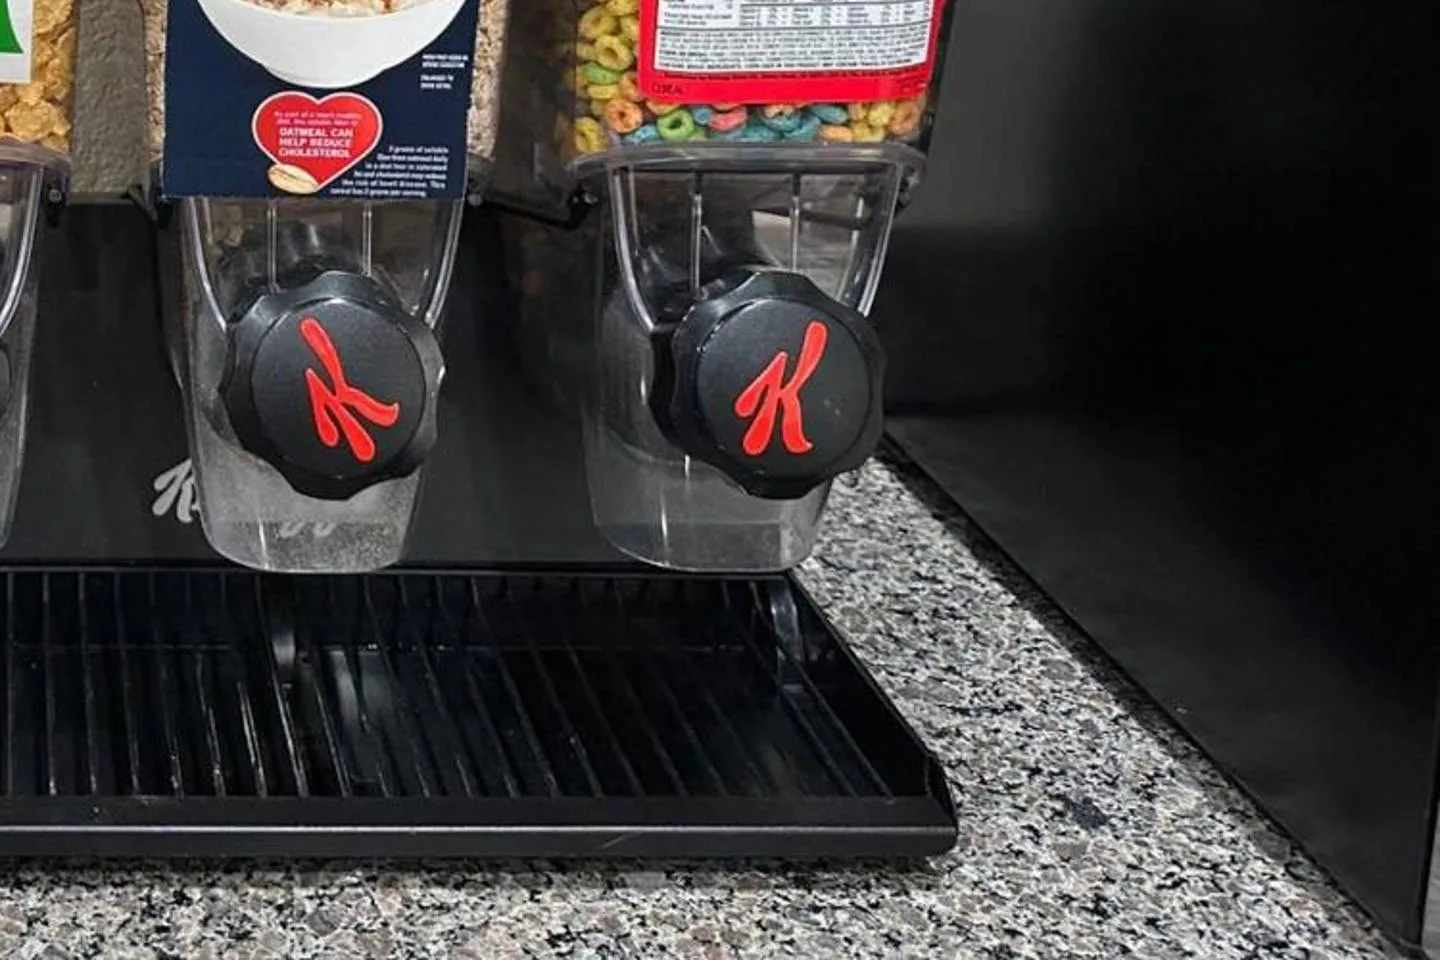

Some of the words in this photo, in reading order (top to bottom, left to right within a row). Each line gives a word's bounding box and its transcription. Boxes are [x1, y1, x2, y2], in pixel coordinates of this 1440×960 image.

[280, 128, 329, 137] OATMEAL
[330, 128, 354, 137] CAN
[280, 138, 307, 147] HELP
[308, 138, 352, 147] REDUCE
[278, 147, 351, 157] CHOLESTEROL
[300, 317, 401, 463] K
[734, 320, 829, 457] K
